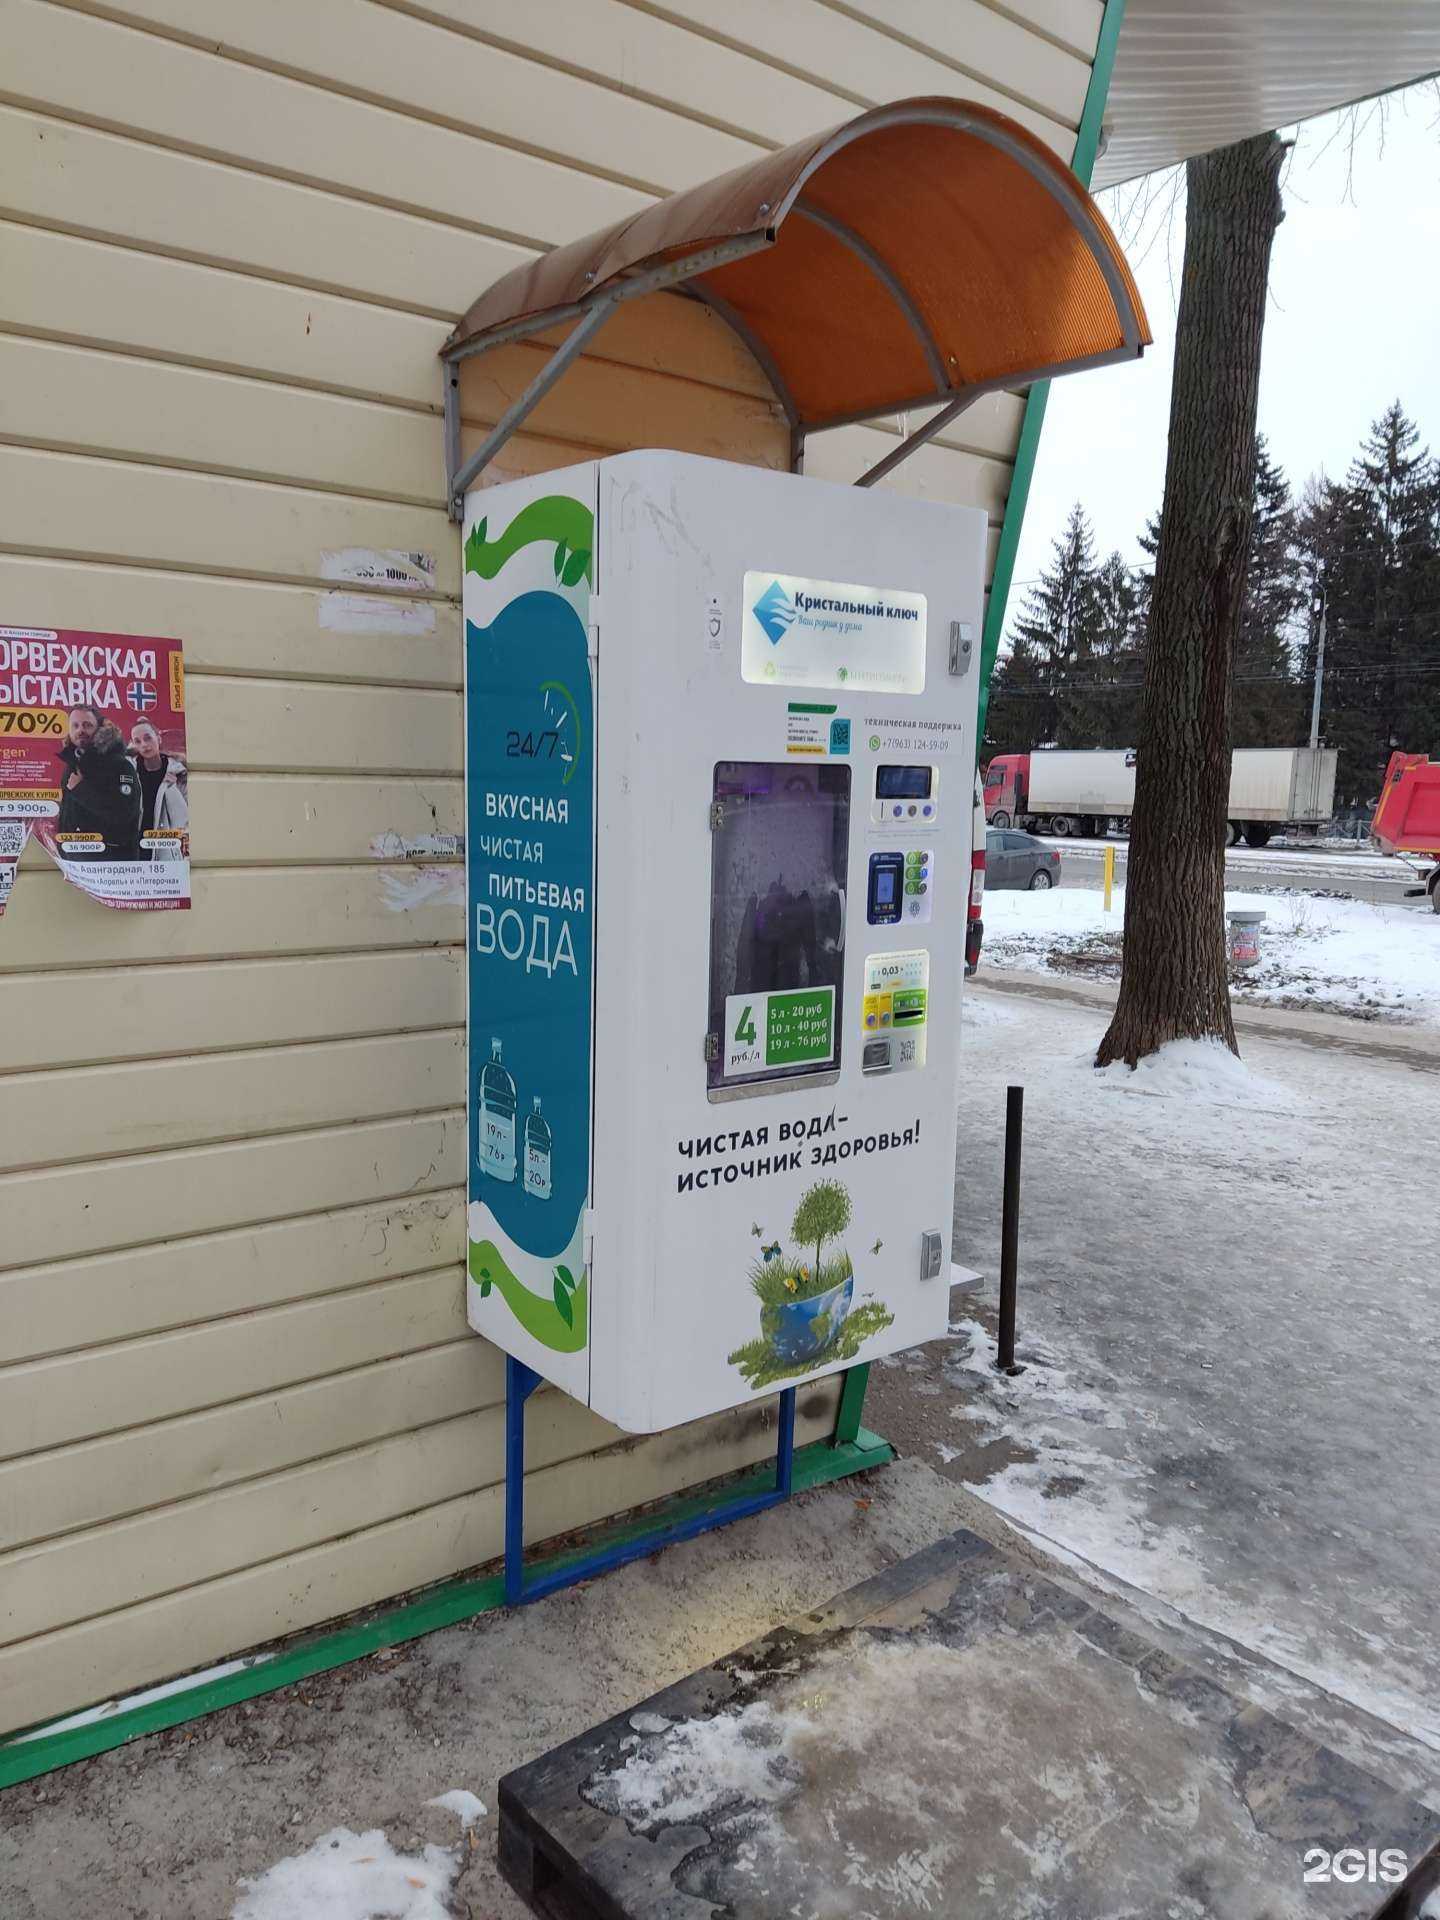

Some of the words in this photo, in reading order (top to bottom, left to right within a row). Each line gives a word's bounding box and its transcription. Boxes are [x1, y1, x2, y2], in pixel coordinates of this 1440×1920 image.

[795, 592, 884, 617] Кристальный
[886, 606, 919, 620] ключ
[864, 718, 917, 728] техническая
[918, 722, 962, 732] поддержка
[506, 731, 559, 758] 24/7
[486, 793, 569, 824] ВКУСНАЯ
[480, 834, 544, 864] ЧИСТАЯ
[149, 864, 165, 874] 185
[488, 873, 585, 913] ПИТЬЕВАЯ
[476, 902, 578, 979] ВОДА
[770, 1009, 777, 1019] 5
[778, 1010, 785, 1018] л
[792, 1006, 804, 1017] 20
[805, 1004, 823, 1017] руб
[734, 1006, 757, 1046] 4
[771, 1024, 782, 1035] 10
[783, 1025, 790, 1033] л
[797, 1020, 809, 1031] 40
[810, 1018, 828, 1032] руб
[771, 1040, 782, 1050] 19
[783, 1040, 790, 1049] л
[797, 1036, 809, 1047] 76
[810, 1034, 827, 1047] руб
[731, 1050, 760, 1065] руб./л
[677, 1150, 802, 1193] ИСТОЧНИК
[811, 1119, 921, 1166] ЗДОРОВЬЯ!
[678, 1126, 769, 1159] ЧИСТАЯ
[529, 1170, 546, 1188] 20р
